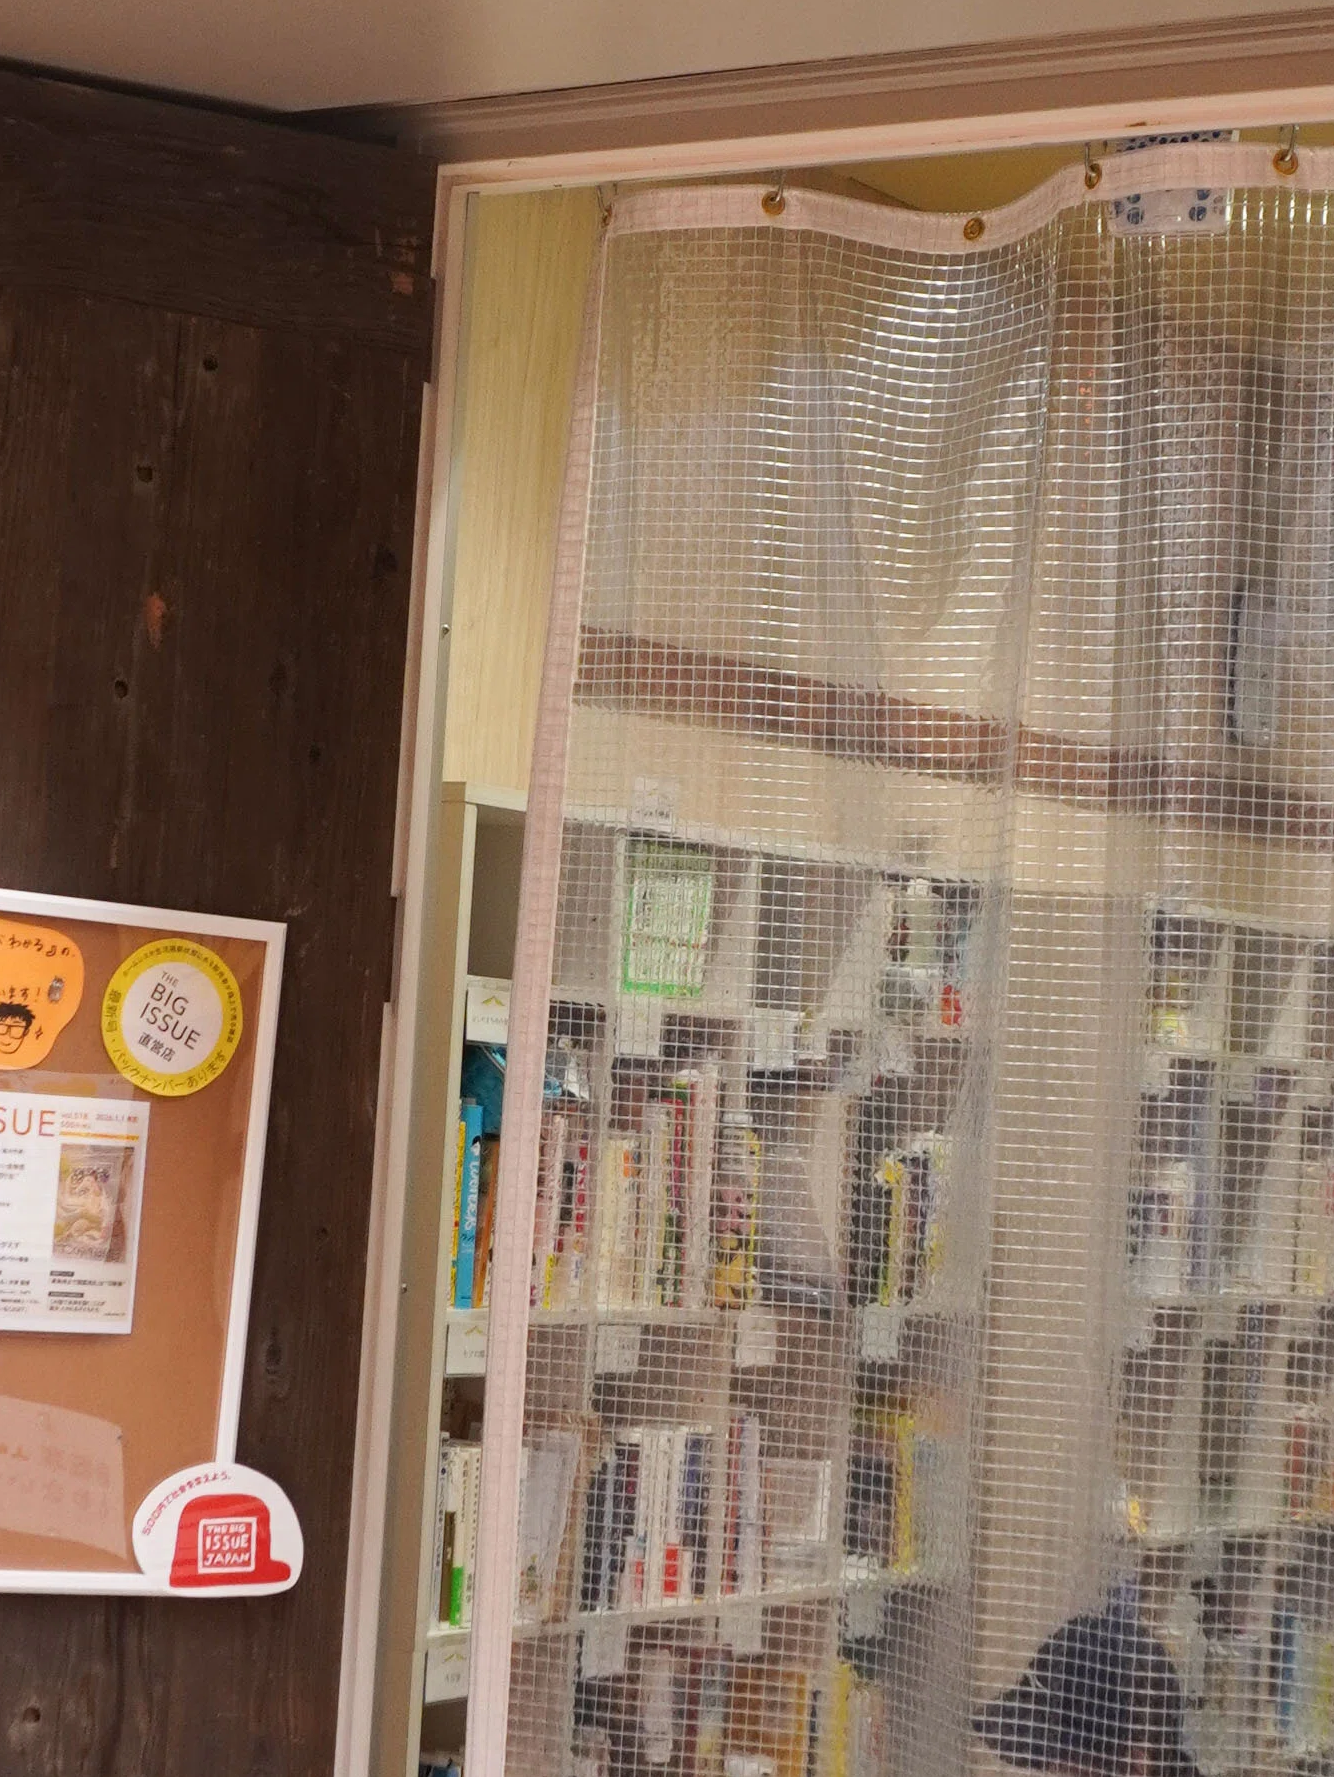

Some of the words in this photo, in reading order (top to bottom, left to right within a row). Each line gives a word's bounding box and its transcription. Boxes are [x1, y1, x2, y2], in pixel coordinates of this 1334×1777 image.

[161, 971, 179, 988] THE
[150, 982, 189, 1016] BIG
[139, 1002, 202, 1050] ISSUE
[138, 1032, 176, 1062] 直営店
[207, 1525, 227, 1534] THE
[229, 1523, 247, 1533] BIG
[205, 1534, 249, 1550] ISSUE
[204, 1552, 251, 1566] JAPAN
